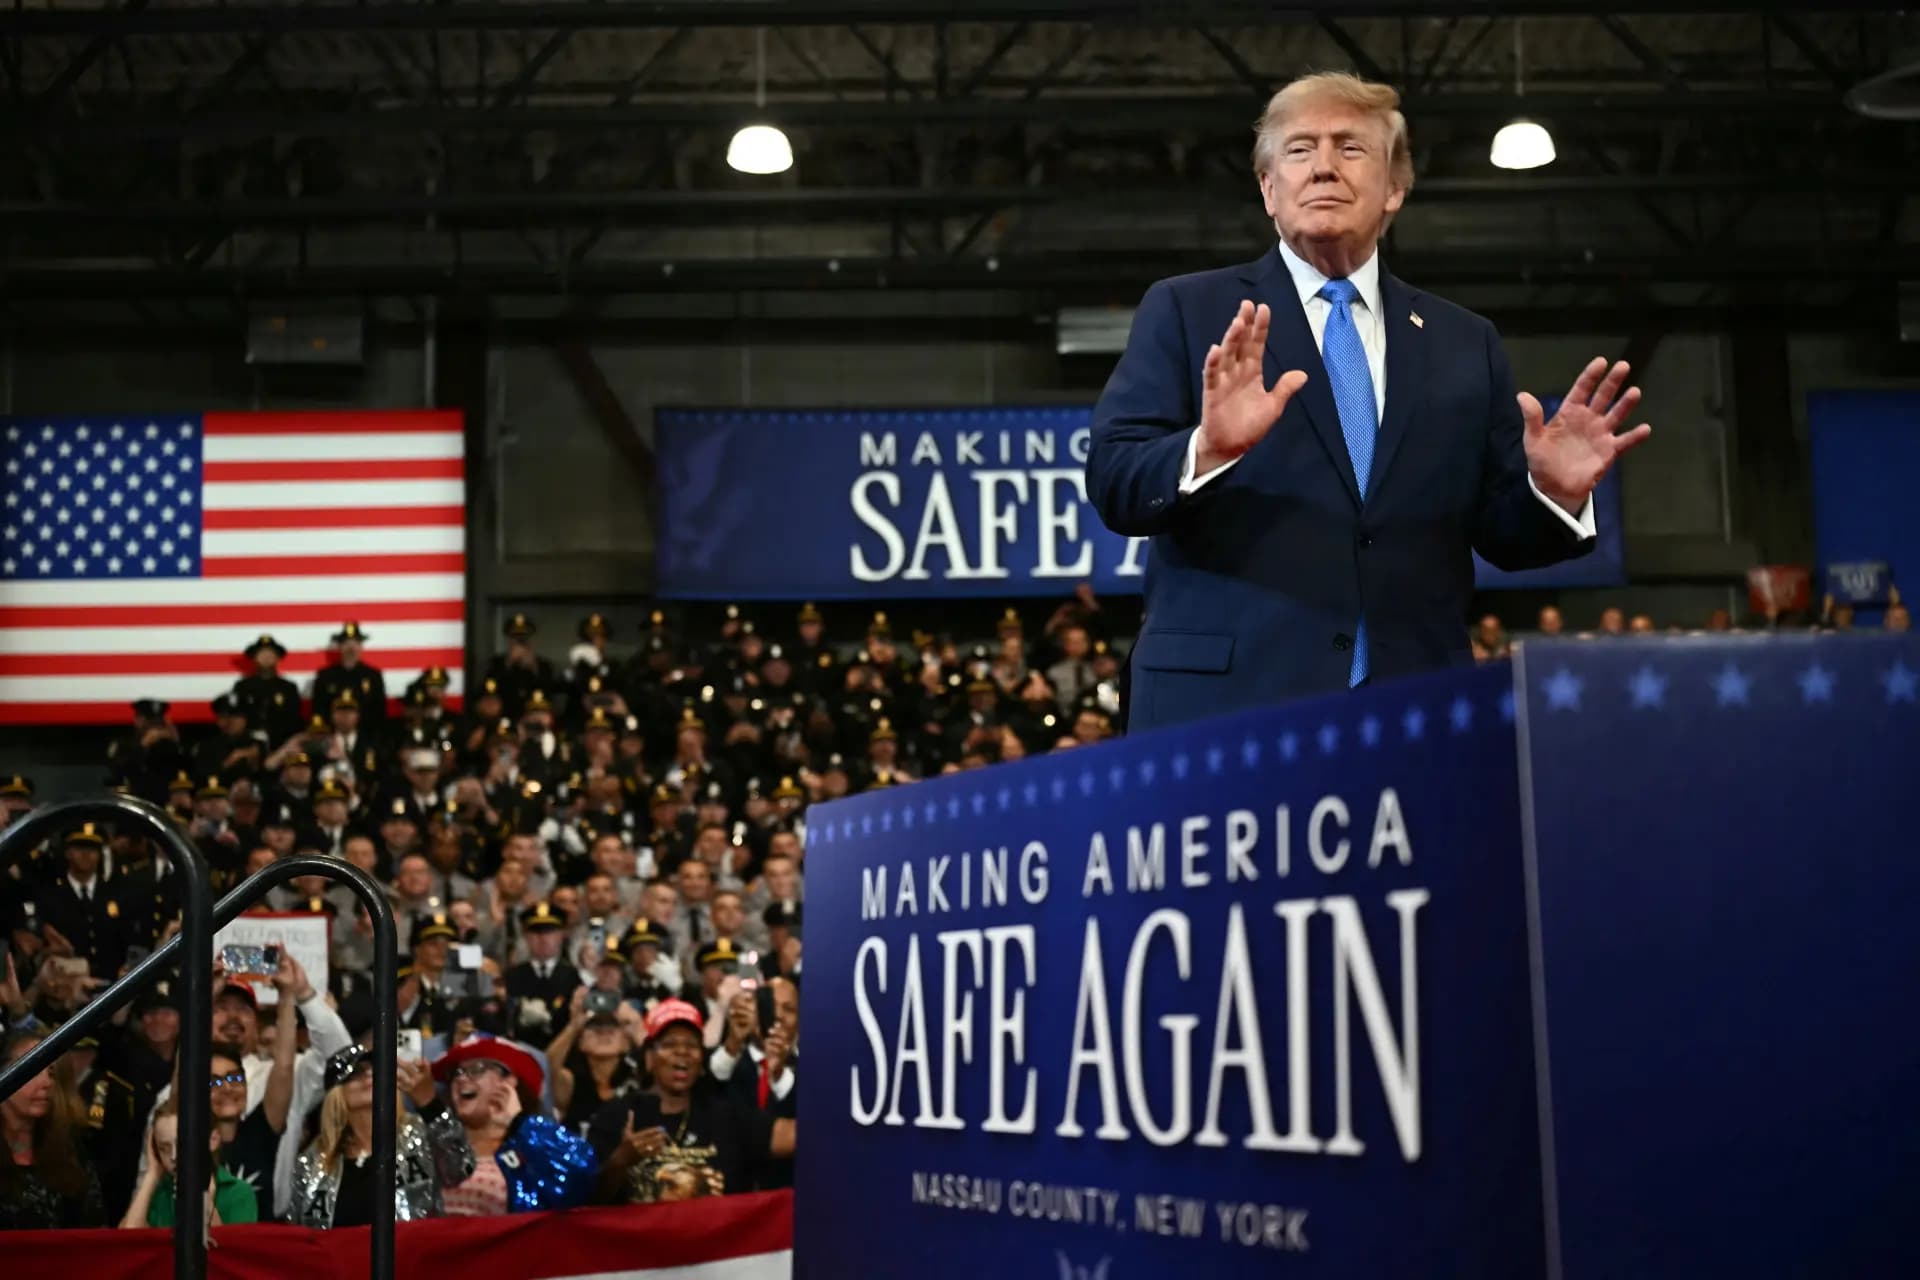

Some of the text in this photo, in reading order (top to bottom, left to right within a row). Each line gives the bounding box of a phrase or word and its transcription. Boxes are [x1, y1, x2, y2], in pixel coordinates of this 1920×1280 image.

[860, 428, 1090, 466] MAKING
[850, 470, 1093, 582] SAFE
[862, 787, 1412, 920] MAKING AMERICA
[851, 888, 1429, 1162] SAFE AGAIN
[912, 1172, 1309, 1252] NASSAU COUNTY, NEW YORK
